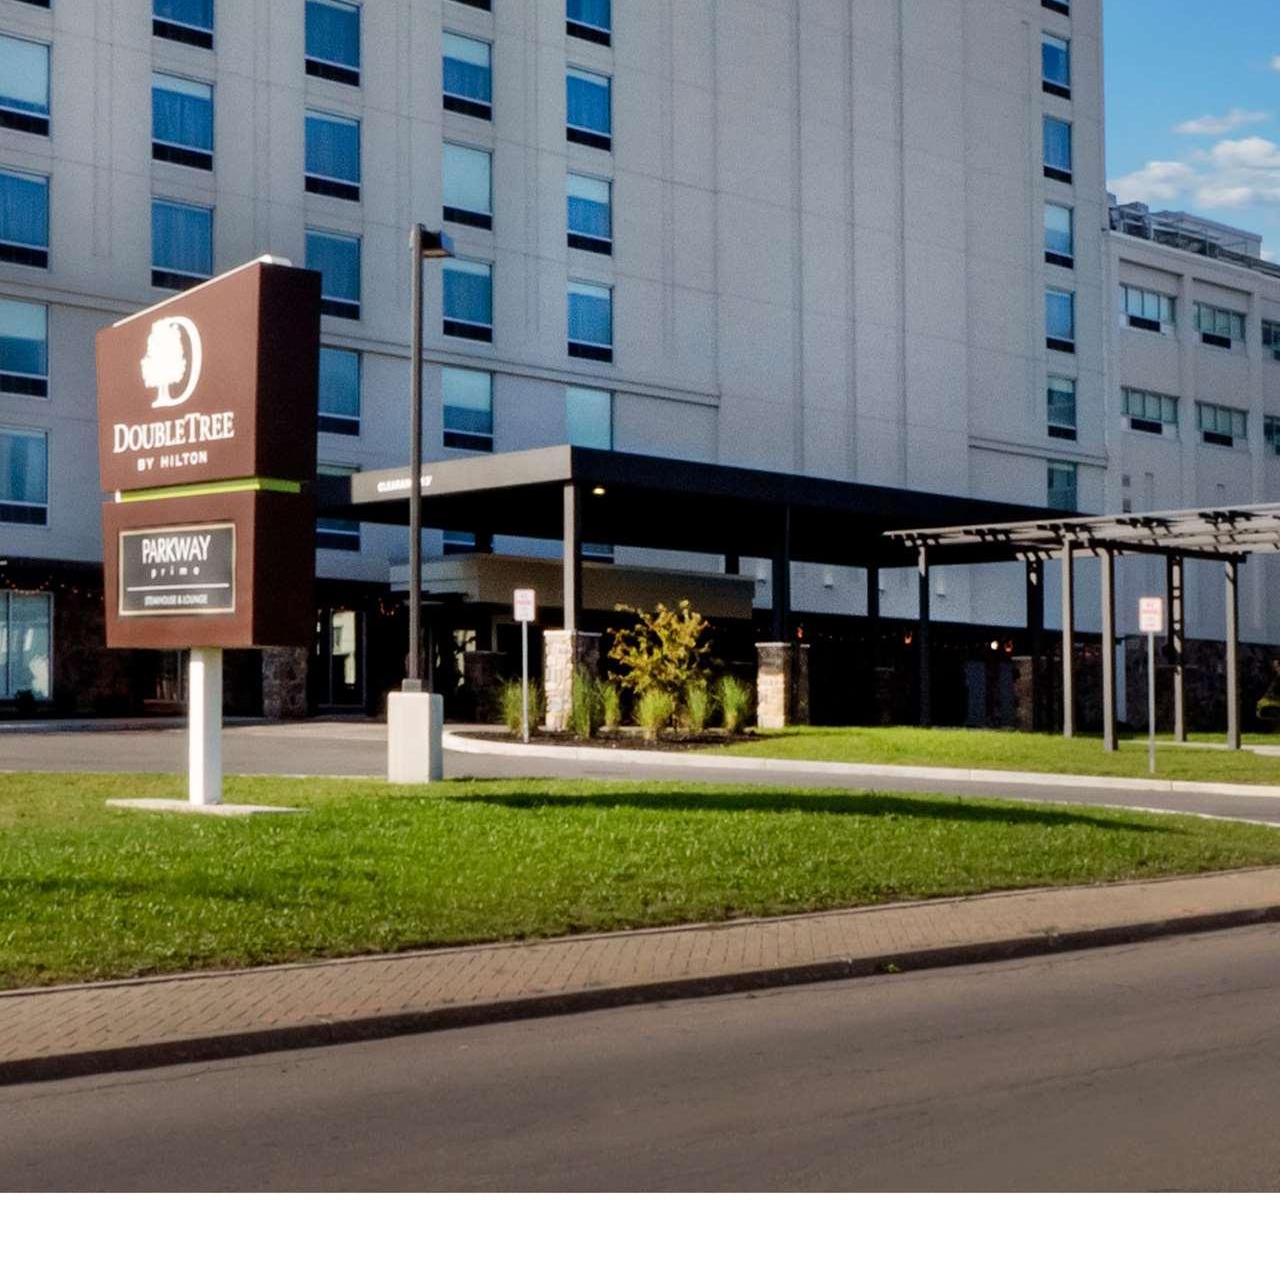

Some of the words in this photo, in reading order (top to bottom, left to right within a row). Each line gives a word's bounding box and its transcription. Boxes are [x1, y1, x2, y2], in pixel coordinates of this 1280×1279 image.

[112, 411, 236, 454] DOUBLETREE
[136, 457, 155, 472] BY
[160, 450, 208, 469] HILTON
[141, 534, 212, 565] PARKWAY
[150, 565, 200, 580] prime
